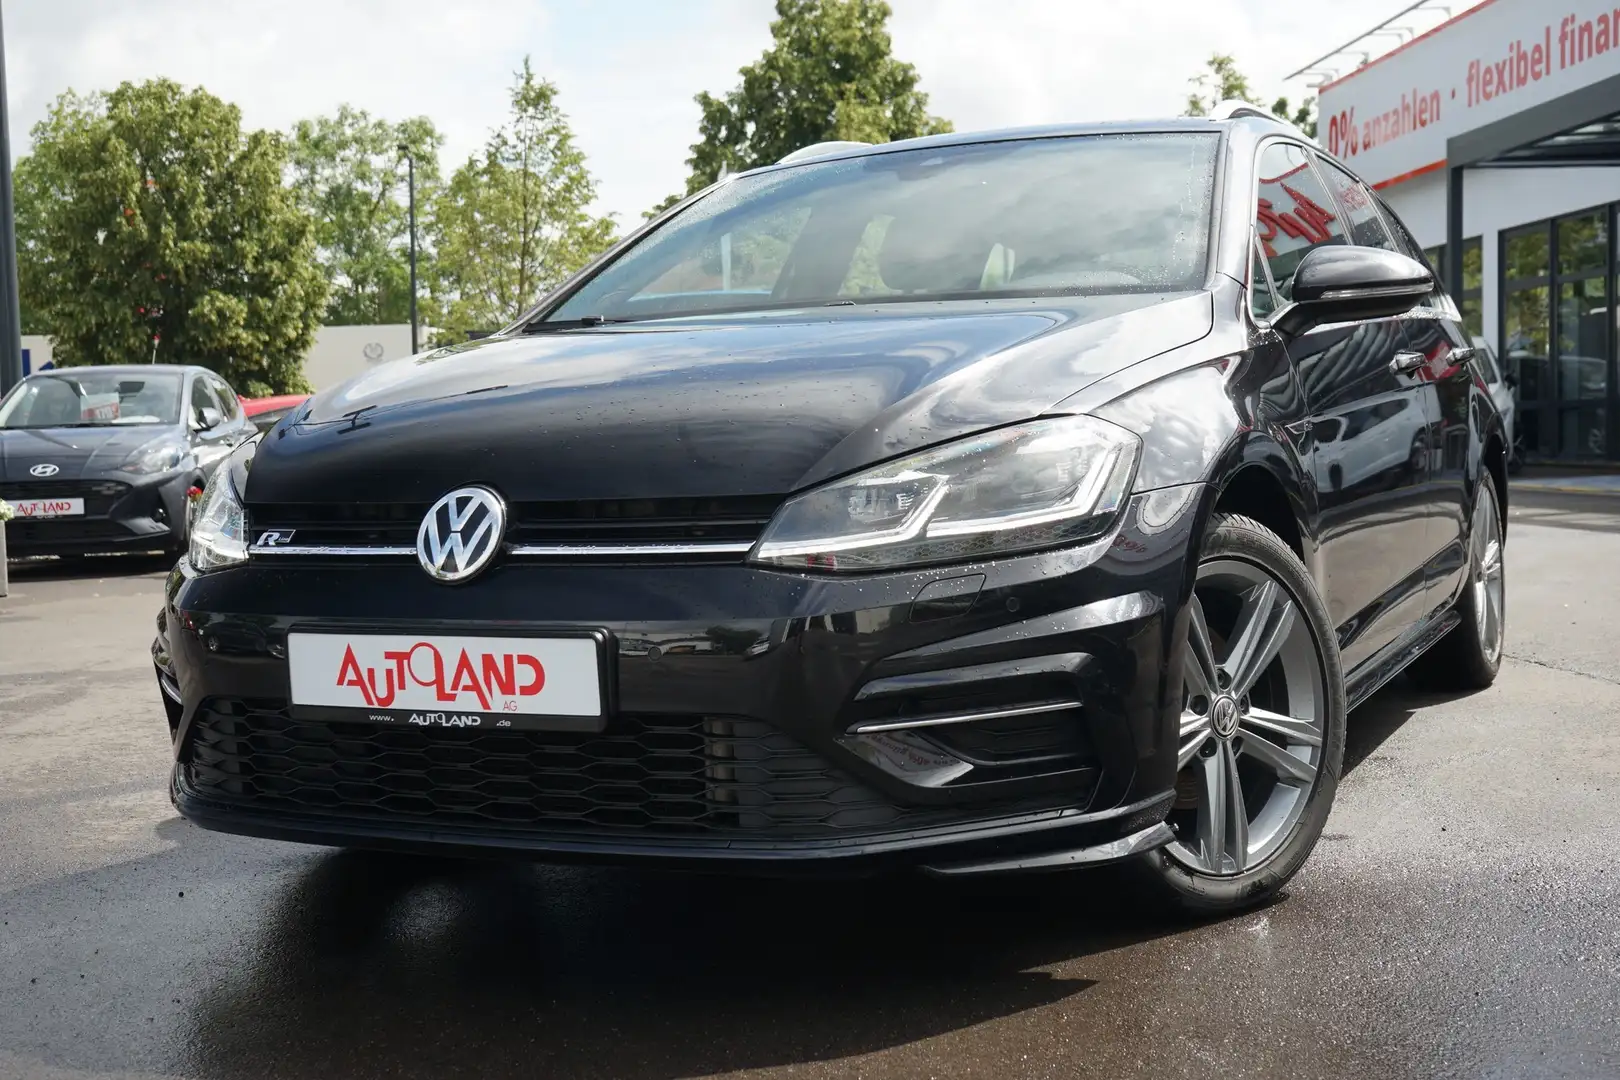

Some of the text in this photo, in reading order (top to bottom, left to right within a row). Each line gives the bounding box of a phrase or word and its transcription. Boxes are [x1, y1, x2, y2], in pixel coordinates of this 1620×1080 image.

[1328, 105, 1359, 160] 0%
[1362, 87, 1441, 152] anzahlen
[1465, 25, 1551, 107] flexibel
[336, 642, 545, 711] AUTOLAND
[502, 700, 518, 711] AG
